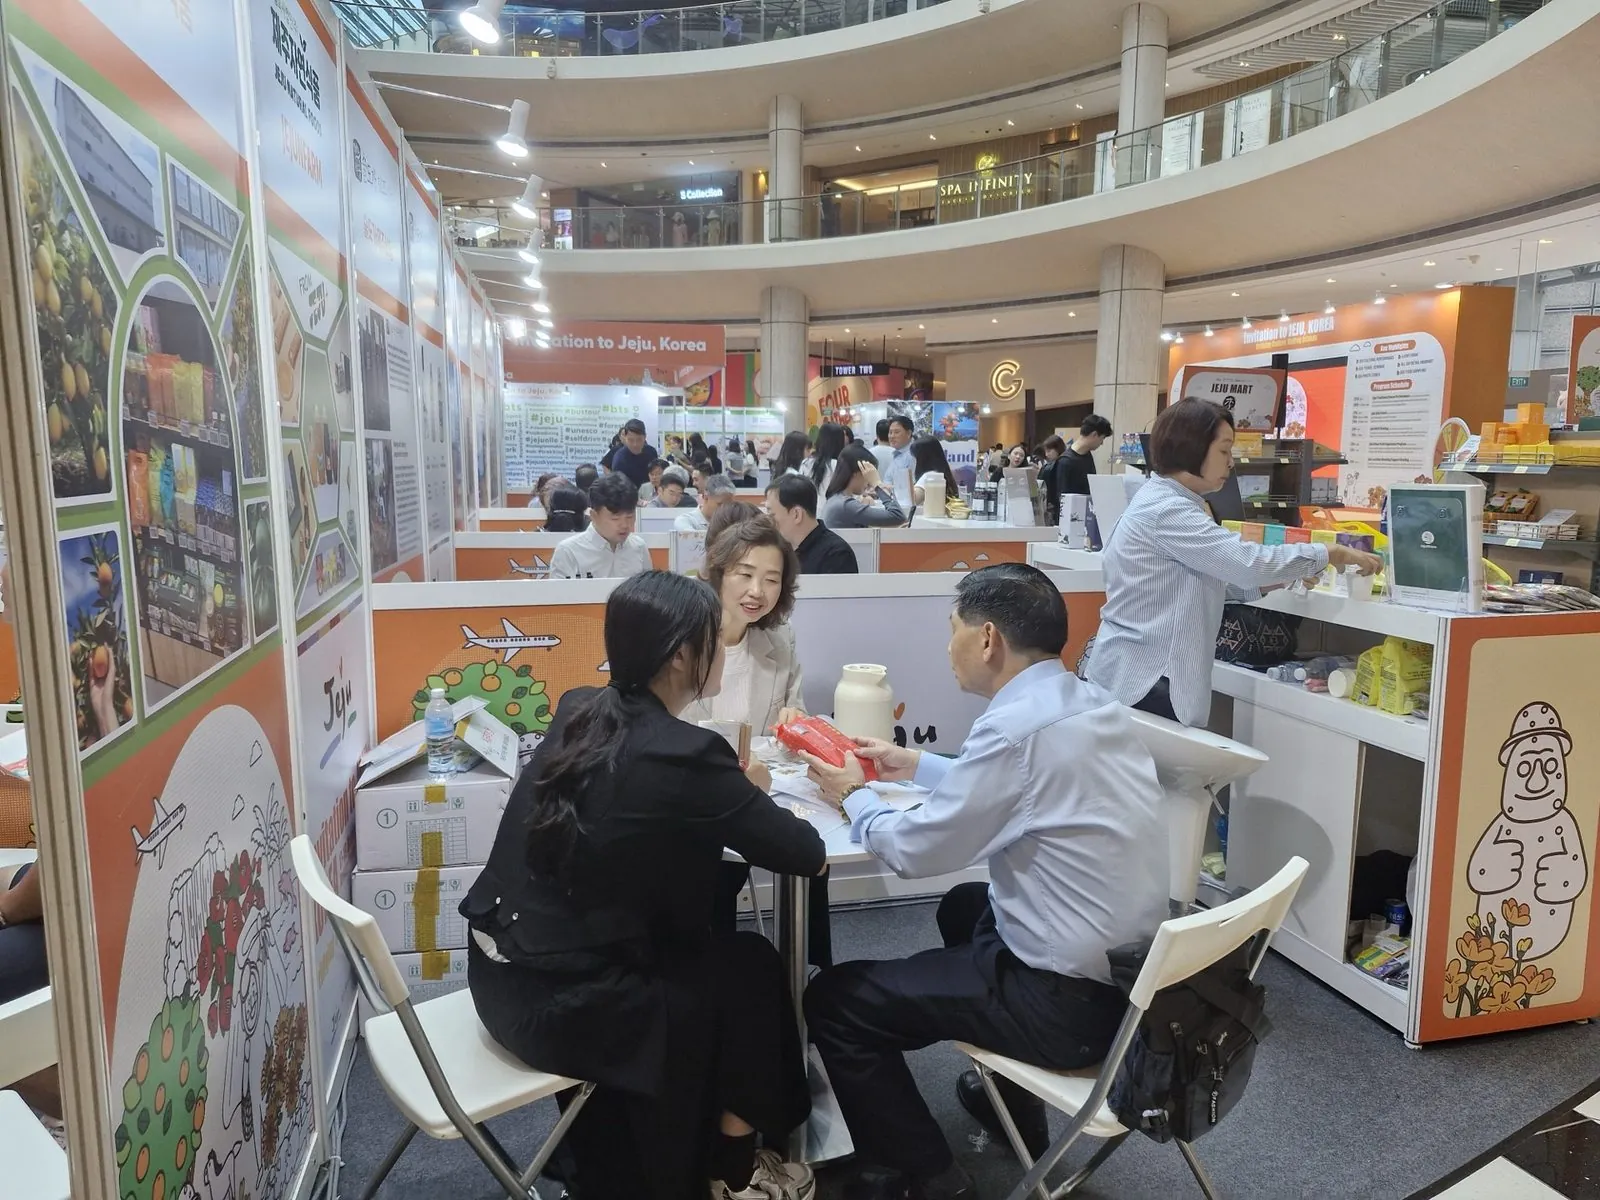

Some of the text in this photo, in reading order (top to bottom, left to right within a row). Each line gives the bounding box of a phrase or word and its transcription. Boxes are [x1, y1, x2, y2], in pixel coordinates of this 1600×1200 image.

[940, 184, 962, 196] SPA
[1308, 316, 1335, 333] KOREA
[598, 336, 614, 349] to
[618, 335, 657, 353] Jeju,
[660, 336, 707, 352] Korea
[836, 365, 873, 375] TOWER TWO
[1211, 383, 1253, 394] JEJU MART
[531, 412, 563, 426] #jeju
[323, 655, 352, 741] Jeju
